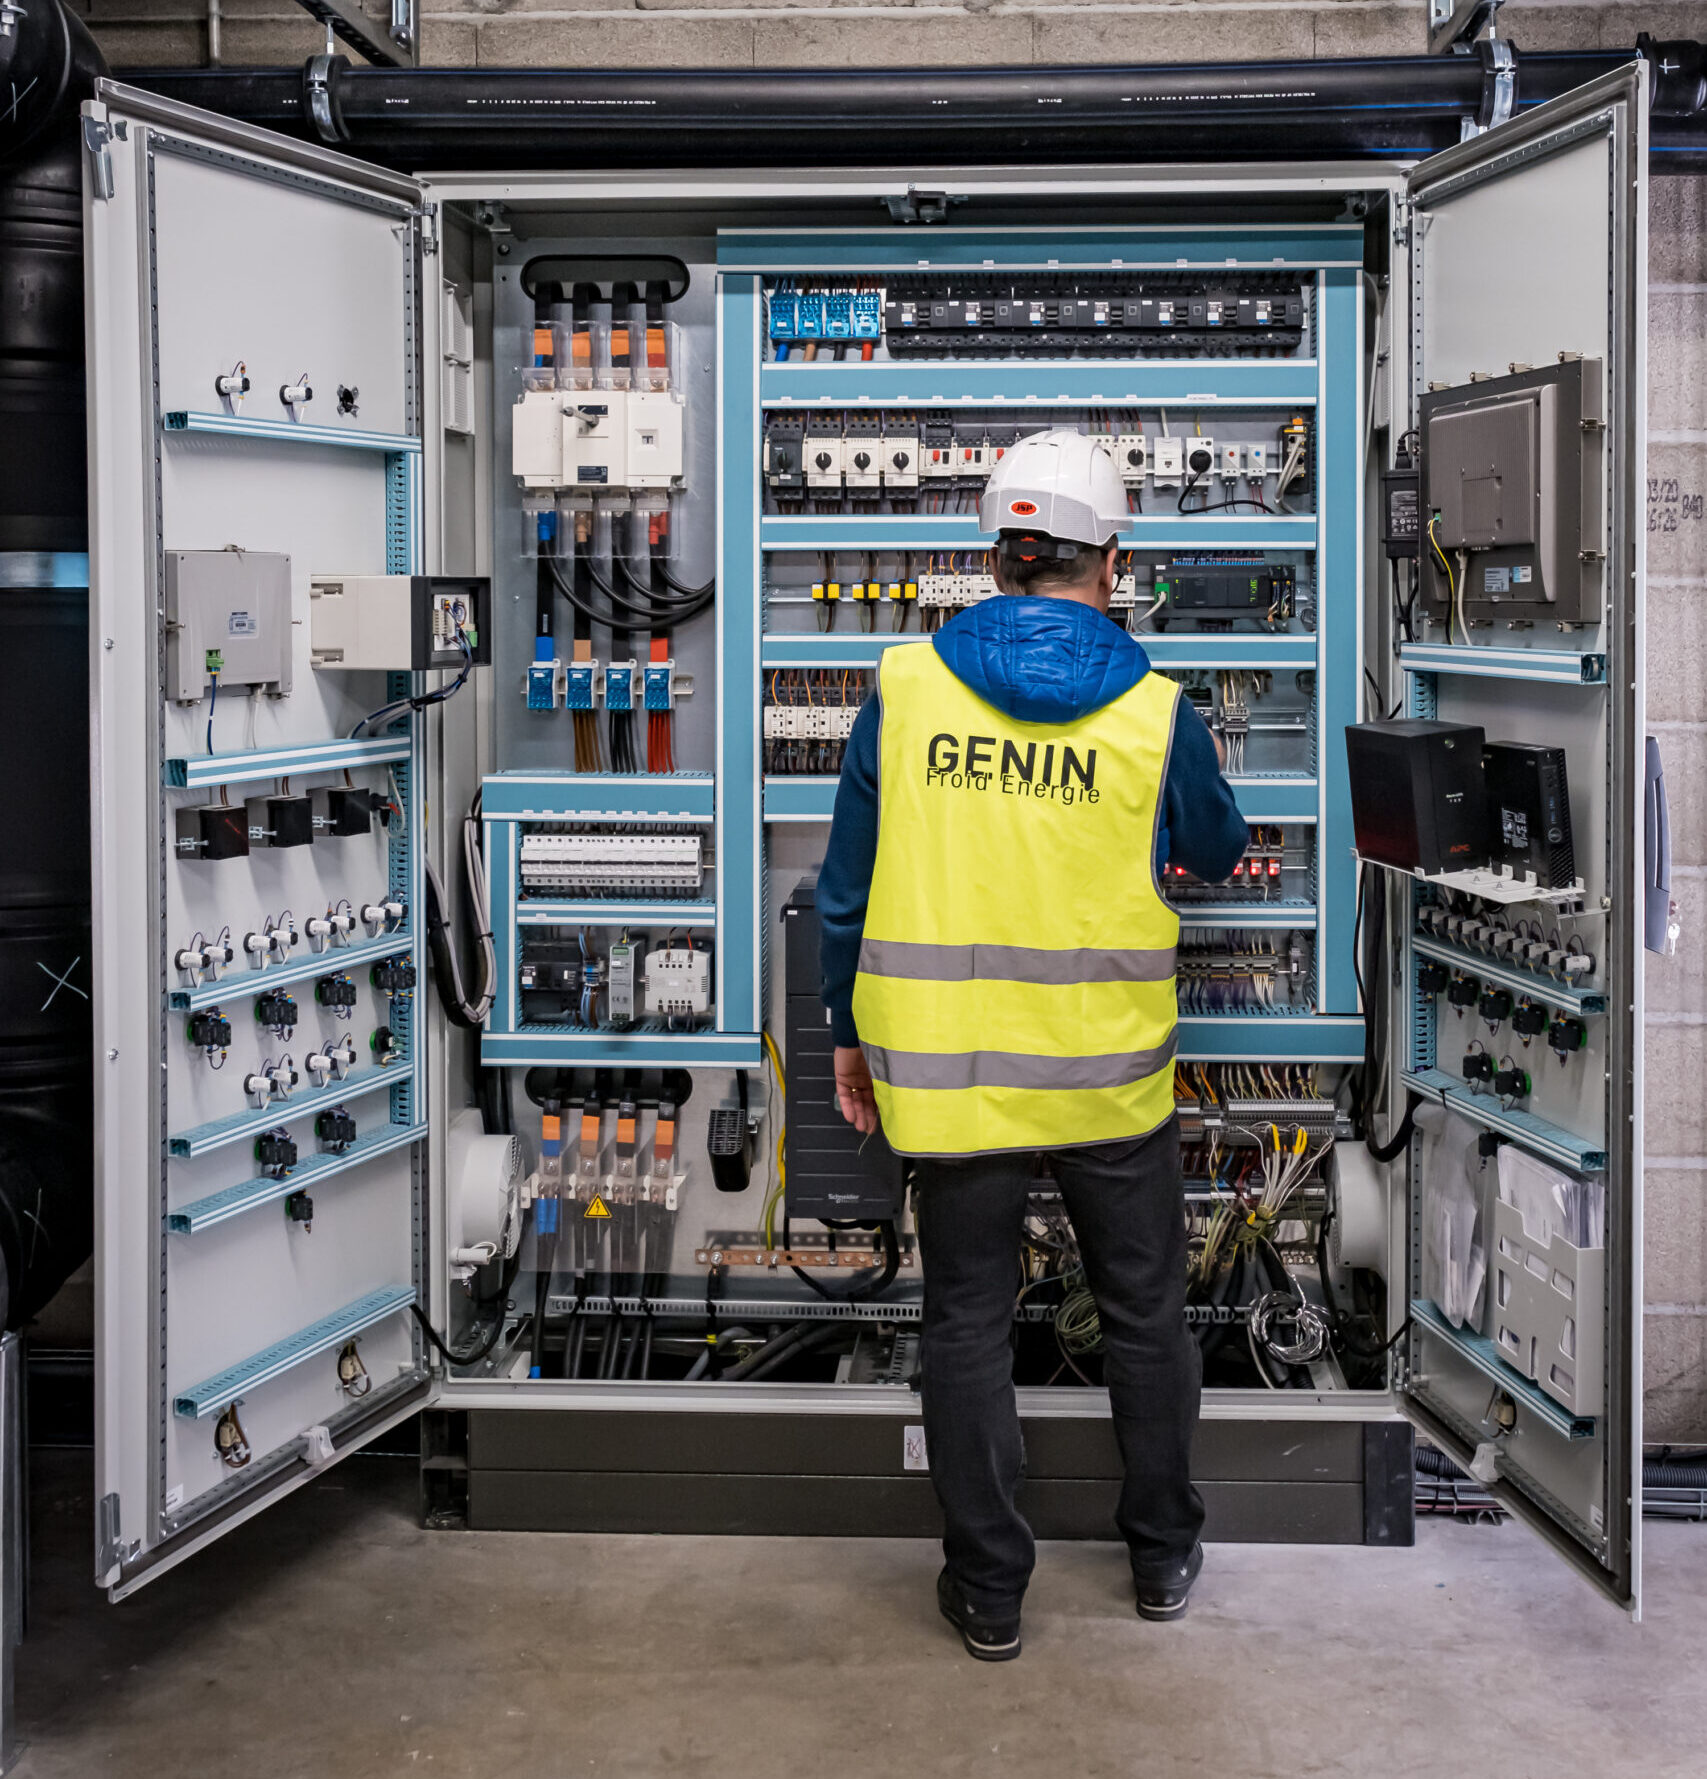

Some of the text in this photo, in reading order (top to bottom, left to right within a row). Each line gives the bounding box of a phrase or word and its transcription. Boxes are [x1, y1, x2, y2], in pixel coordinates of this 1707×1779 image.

[1016, 504, 1033, 512] JSP
[927, 733, 1097, 791] GENIN
[926, 767, 1100, 806] Froid Energie
